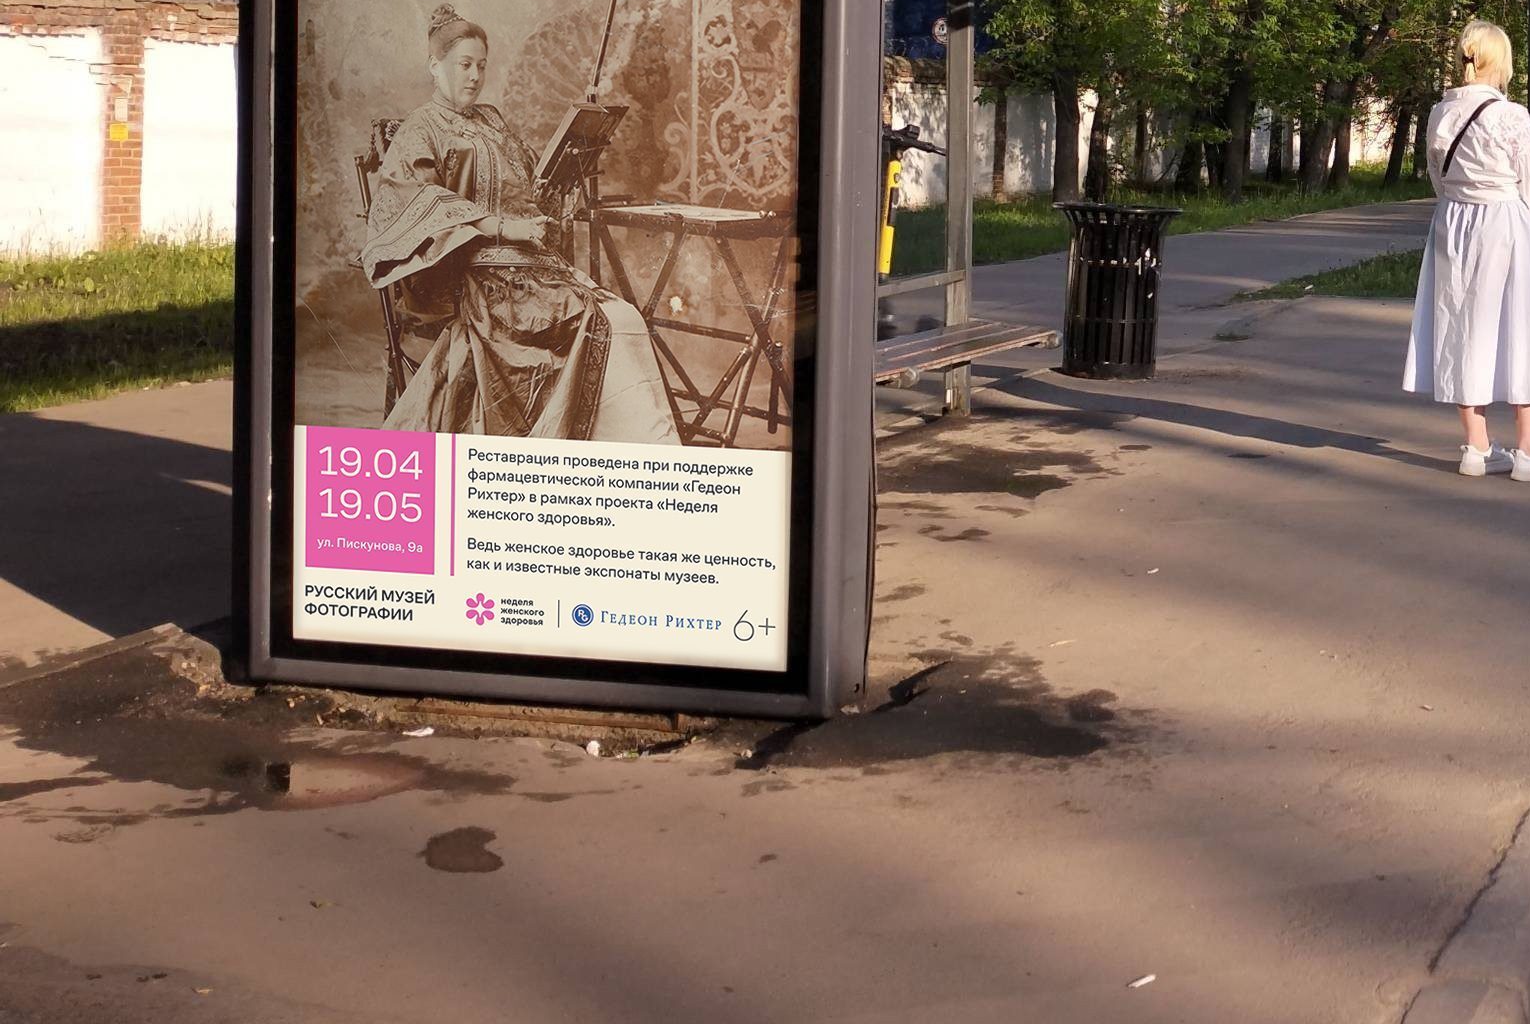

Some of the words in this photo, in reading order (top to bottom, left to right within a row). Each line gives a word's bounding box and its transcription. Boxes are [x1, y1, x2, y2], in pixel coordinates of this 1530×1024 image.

[319, 446, 423, 480] 19.04
[468, 448, 560, 467] Реставрация
[563, 456, 640, 471] проведена
[643, 460, 670, 474] при
[673, 462, 754, 478] поддержке
[467, 467, 605, 488] фармацевтической
[608, 478, 679, 492] компании
[682, 479, 741, 496] «Гедеон
[319, 488, 422, 523] 19.05
[468, 486, 526, 505] Рихтер»
[529, 493, 537, 503] в
[540, 494, 592, 507] рамках
[595, 497, 654, 510] проекта
[656, 498, 718, 514] «Неделя
[467, 509, 534, 522] женского
[537, 513, 615, 527] здоровья».
[317, 539, 334, 549] ул.
[337, 537, 405, 553] Пискунова,
[407, 541, 423, 553] 9а
[467, 537, 502, 553] Ведь
[504, 542, 565, 556] женское
[568, 546, 635, 561] здоровье
[637, 550, 678, 562] такая
[681, 553, 701, 564] же
[704, 554, 776, 571] ценность,
[466, 559, 491, 570] как
[493, 561, 502, 571] и
[505, 562, 581, 576] известные
[584, 566, 661, 581] экспонаты
[664, 571, 719, 585] музеев.
[304, 584, 378, 601] РУССКИЙ
[381, 589, 435, 605] МУЗЕЙ
[500, 598, 534, 607] неделя
[304, 602, 413, 622] ФОТОГРАФИИ
[500, 607, 545, 617] женского
[500, 616, 544, 626] здоровья
[733, 609, 776, 642] 6+
